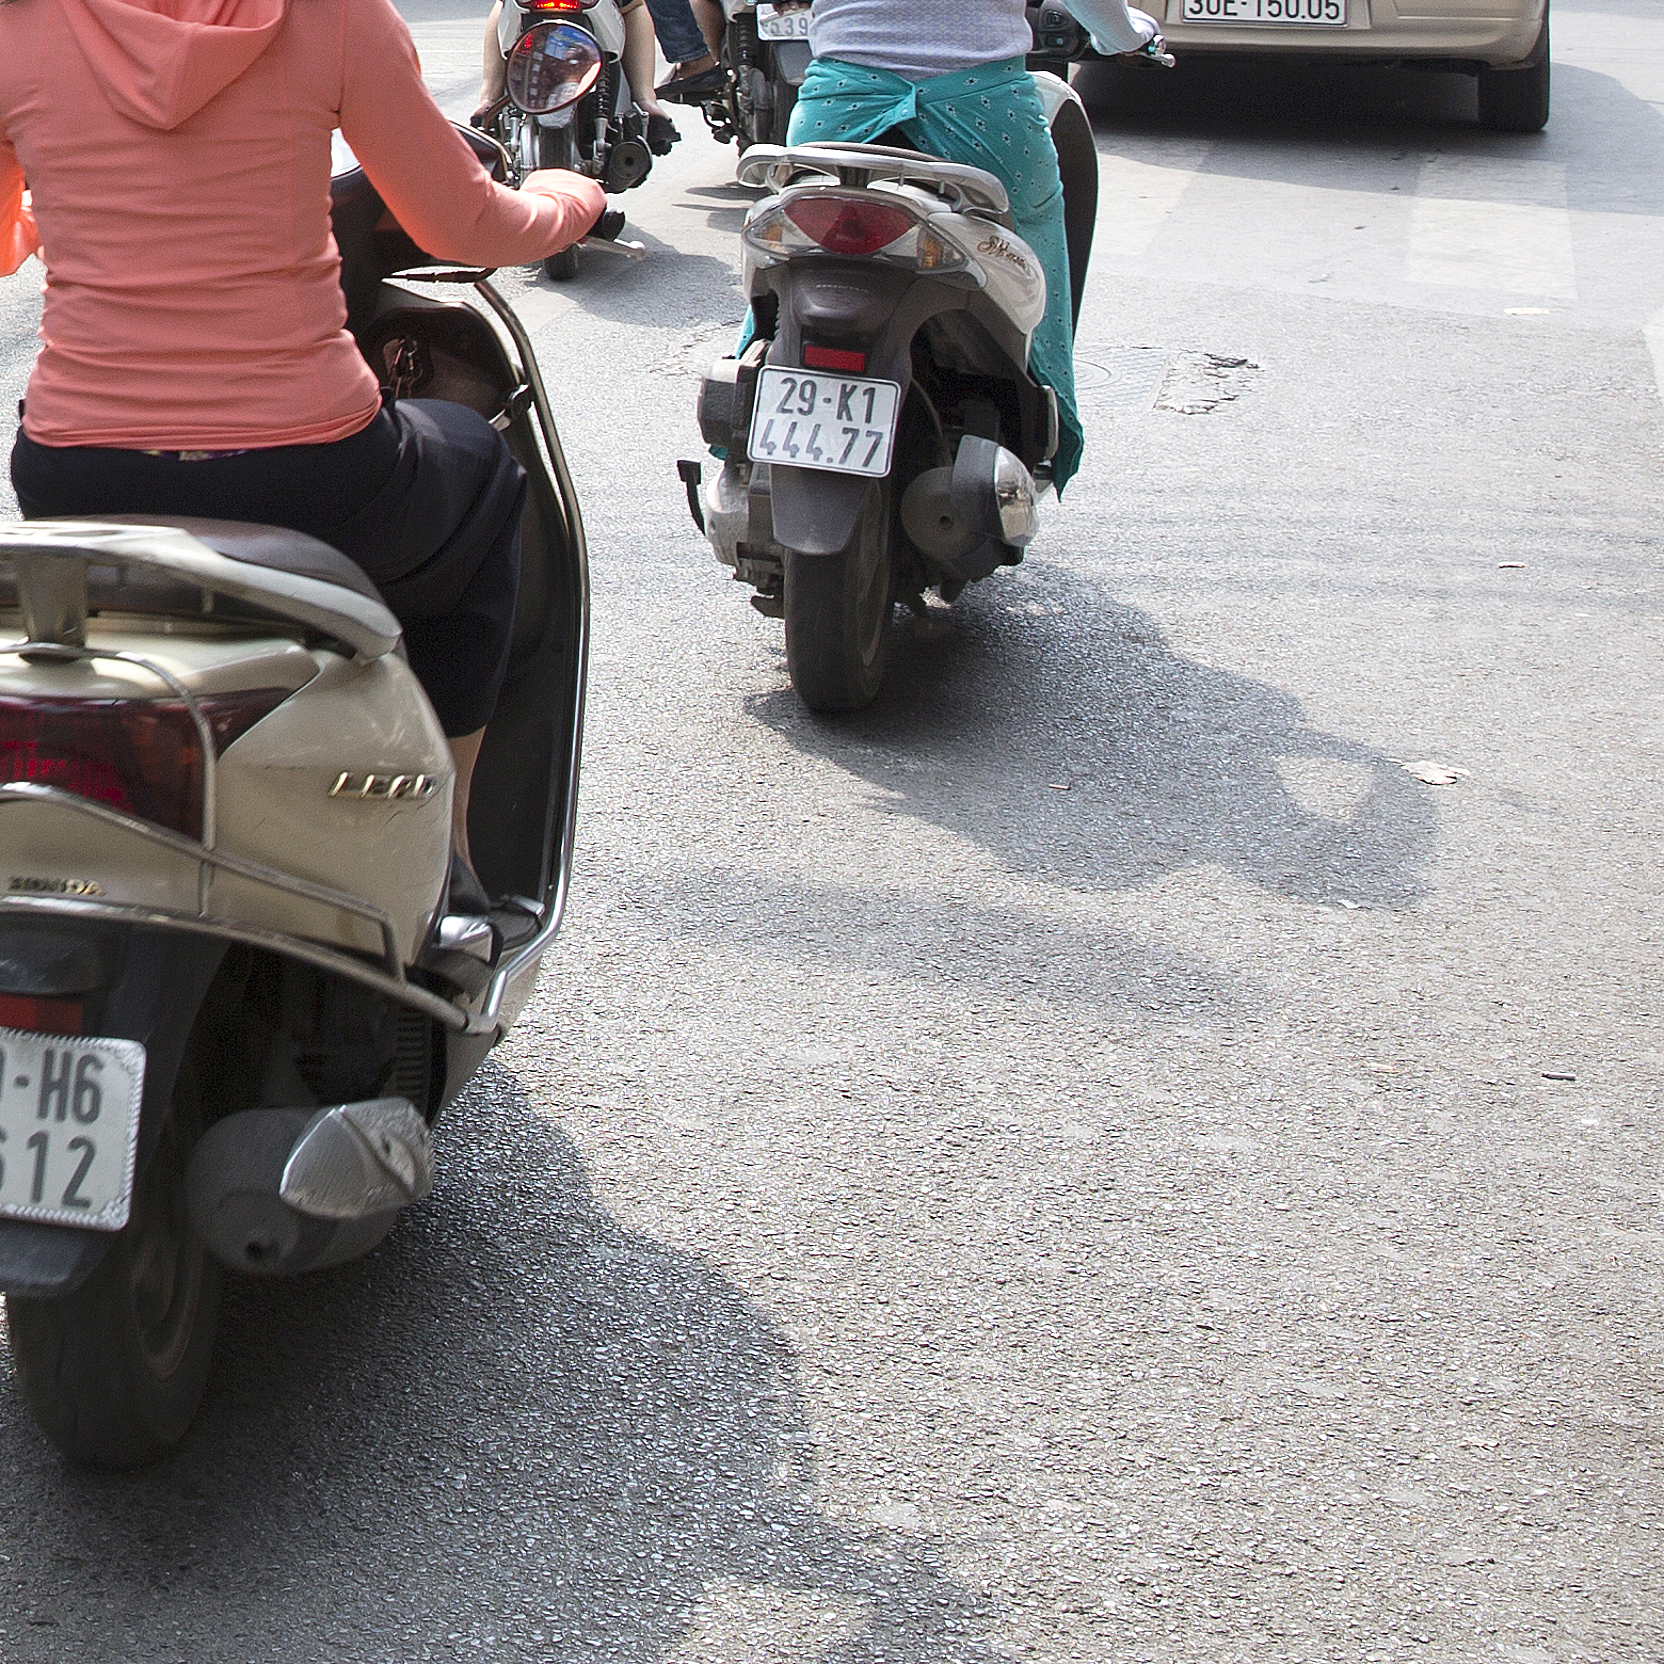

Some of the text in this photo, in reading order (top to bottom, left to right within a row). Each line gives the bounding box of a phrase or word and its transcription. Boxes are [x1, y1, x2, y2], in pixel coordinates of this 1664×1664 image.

[775, 376, 876, 424] 29-K1
[758, 418, 884, 468] 444.77
[327, 770, 436, 799] LEAD
[7, 875, 105, 897] HONDA
